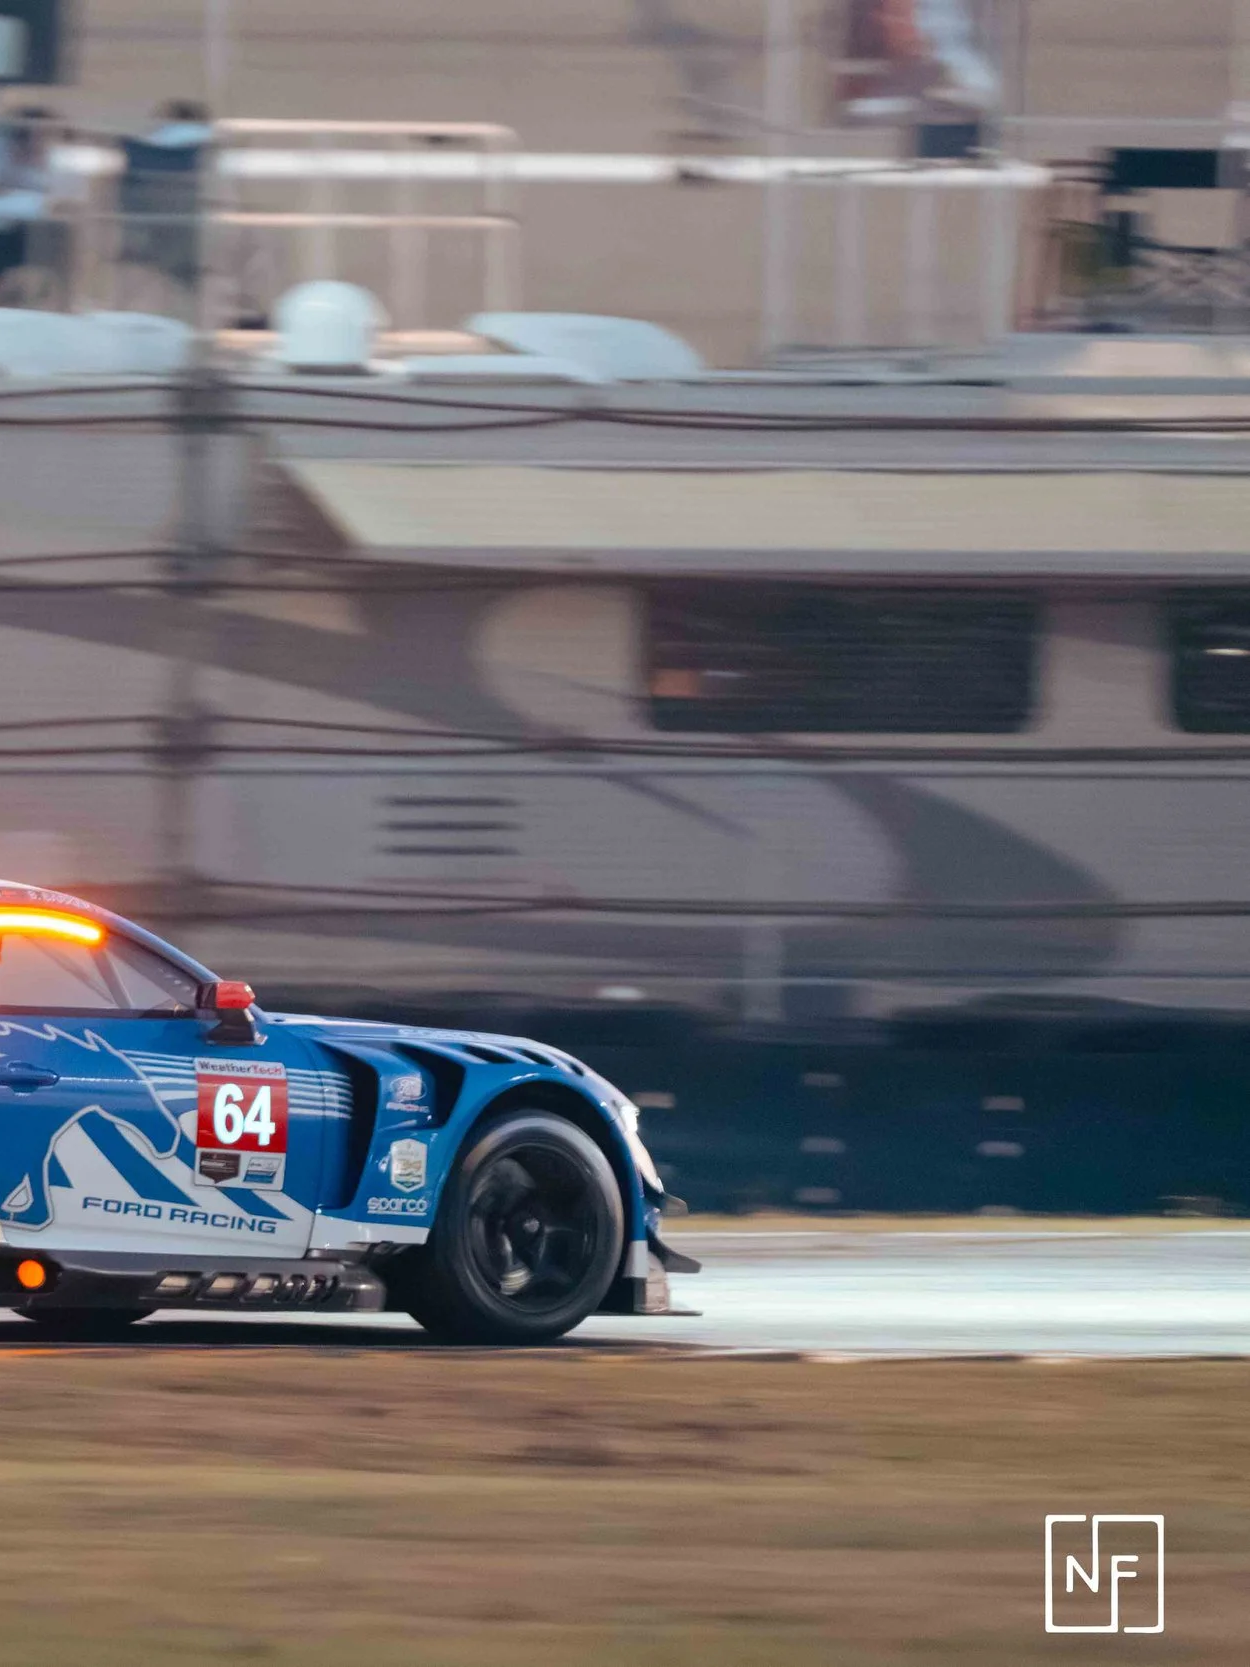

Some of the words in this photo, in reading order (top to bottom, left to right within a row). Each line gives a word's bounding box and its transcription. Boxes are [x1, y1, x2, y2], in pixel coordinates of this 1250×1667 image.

[198, 1061, 282, 1075] WeatherTech
[214, 1083, 276, 1146] 64
[82, 1196, 162, 1219] FORD
[169, 1208, 277, 1234] RACING
[367, 1196, 428, 1213] sparco
